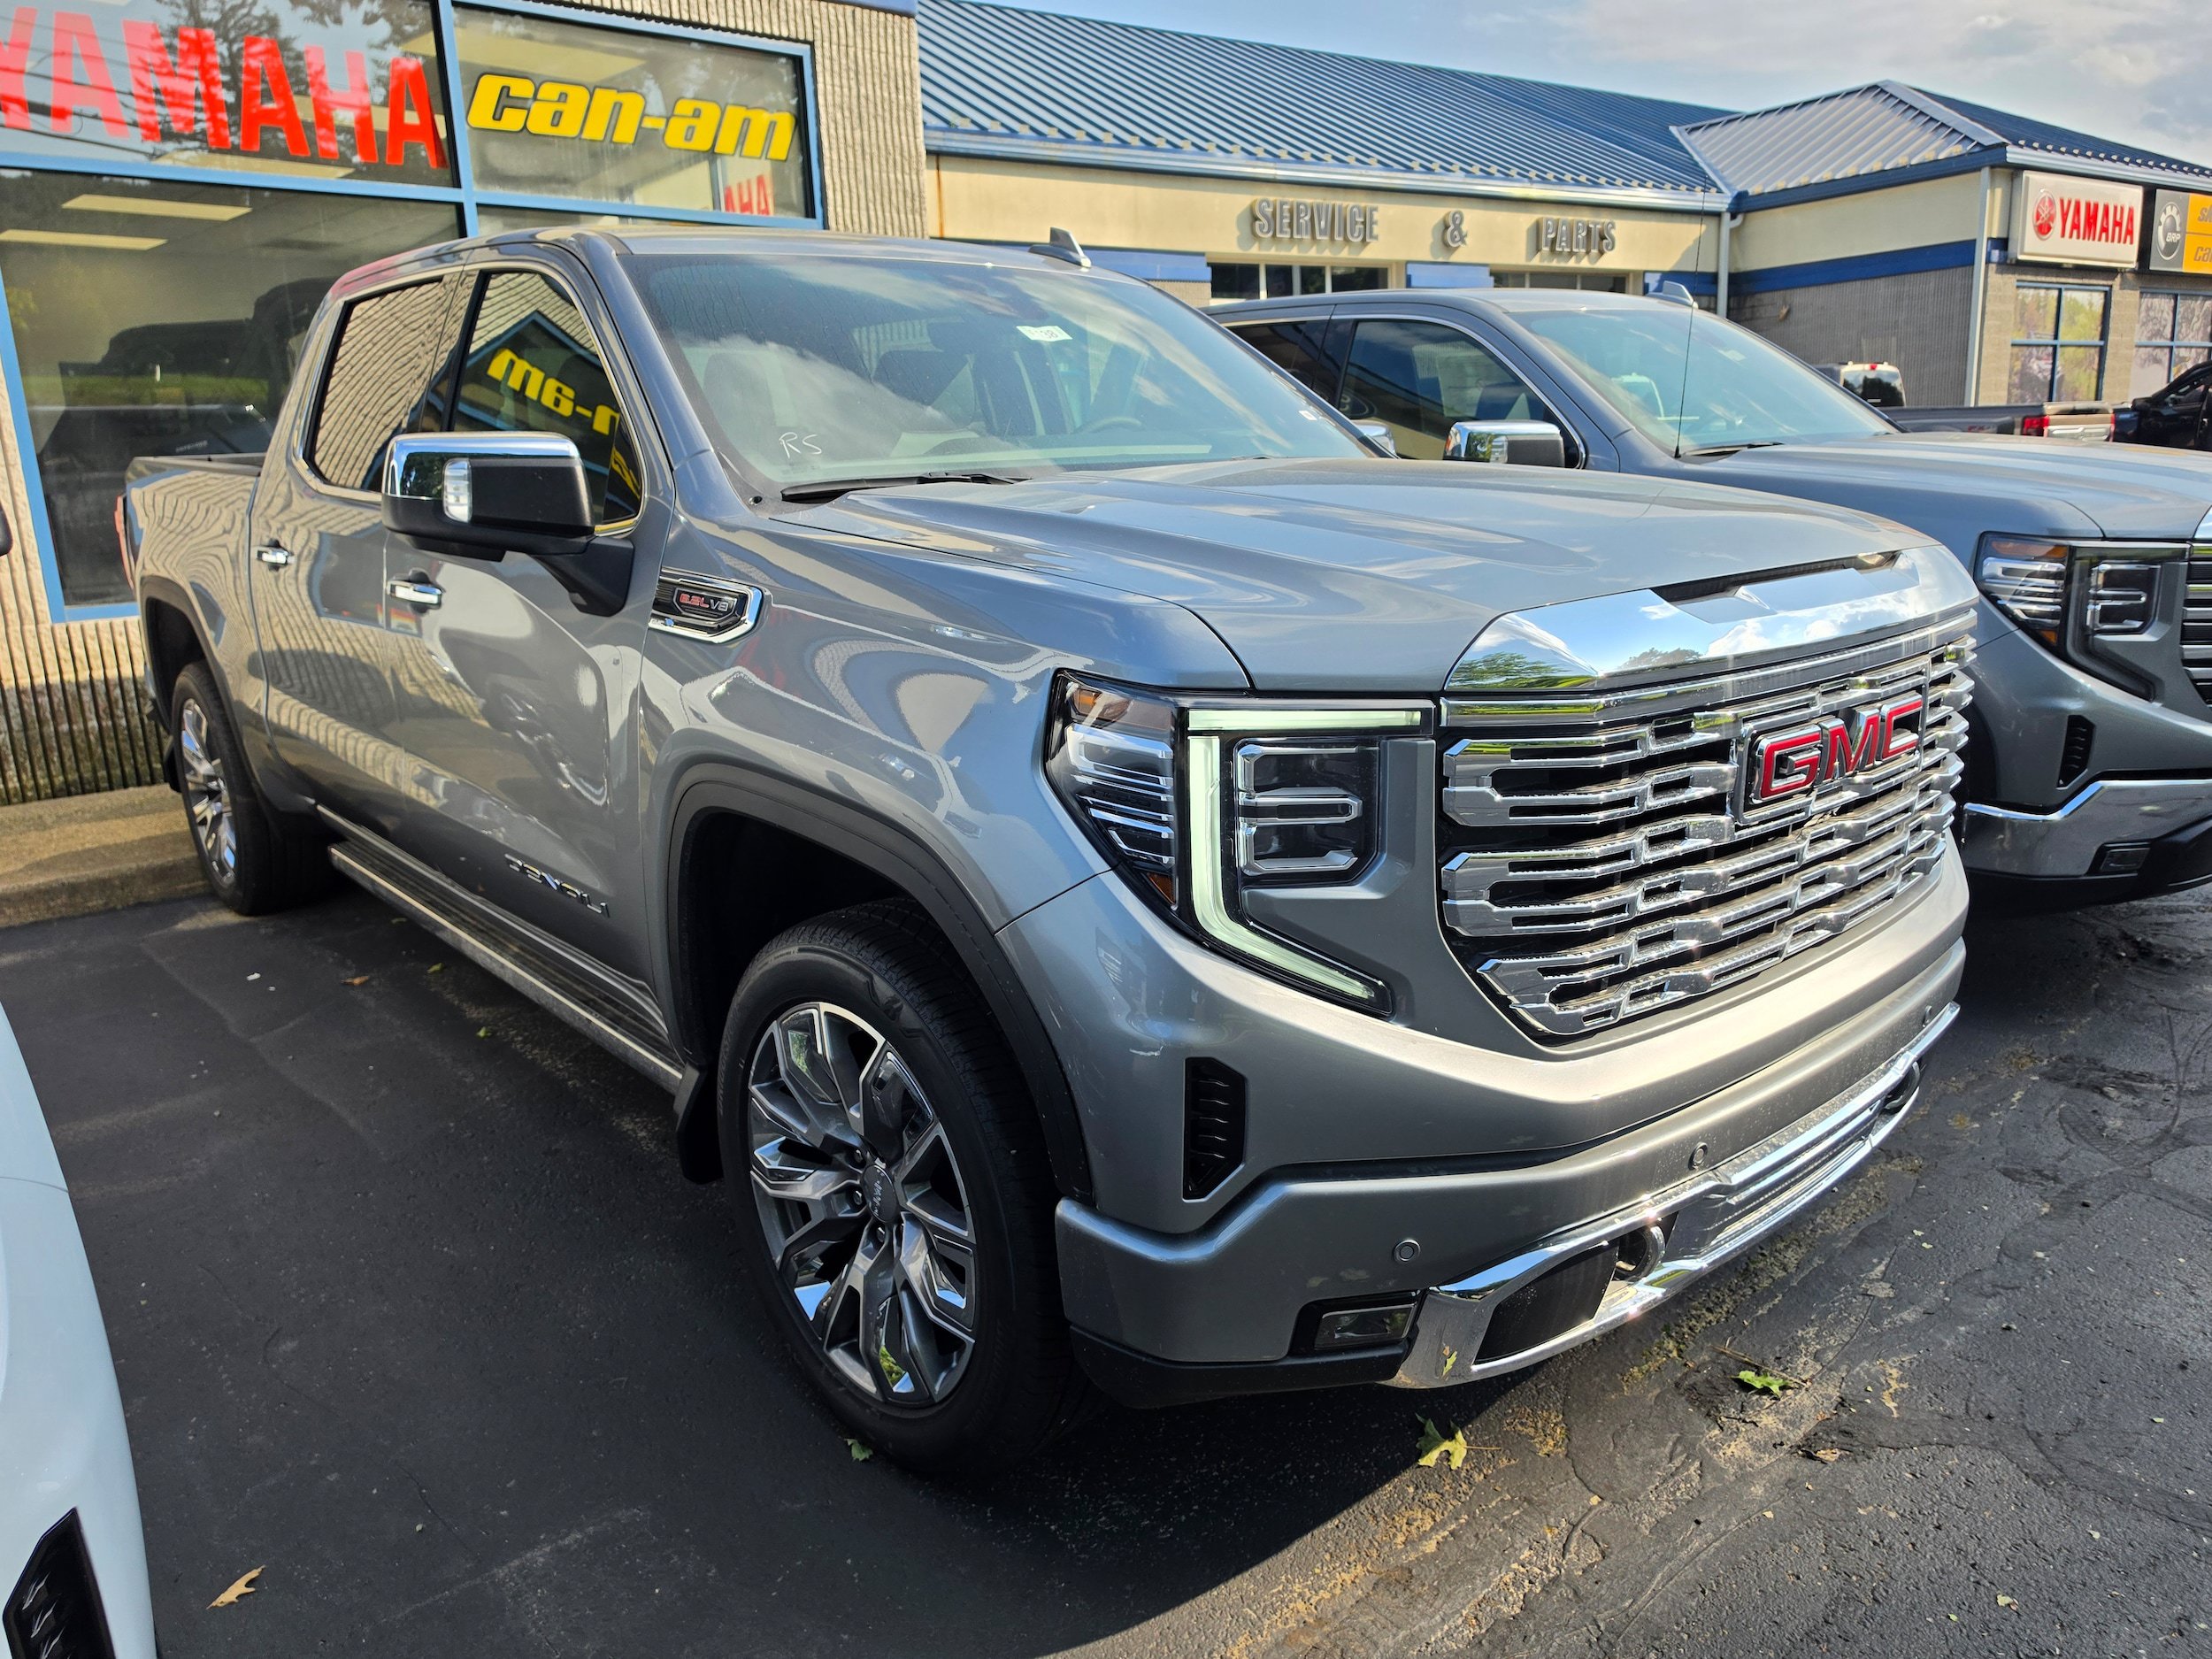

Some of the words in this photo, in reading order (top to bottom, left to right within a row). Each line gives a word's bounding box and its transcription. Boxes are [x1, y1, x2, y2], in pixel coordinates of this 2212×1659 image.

[0, 5, 449, 169] YAMAHA
[466, 73, 796, 161] can-am
[1251, 197, 1379, 243] SERVICE
[1443, 210, 1469, 248] &
[1540, 216, 1617, 254] PARTS
[2059, 196, 2135, 245] YAMAHA
[2166, 232, 2181, 243] BRP
[2193, 246, 2212, 264] ca
[1757, 691, 1924, 802] GMC
